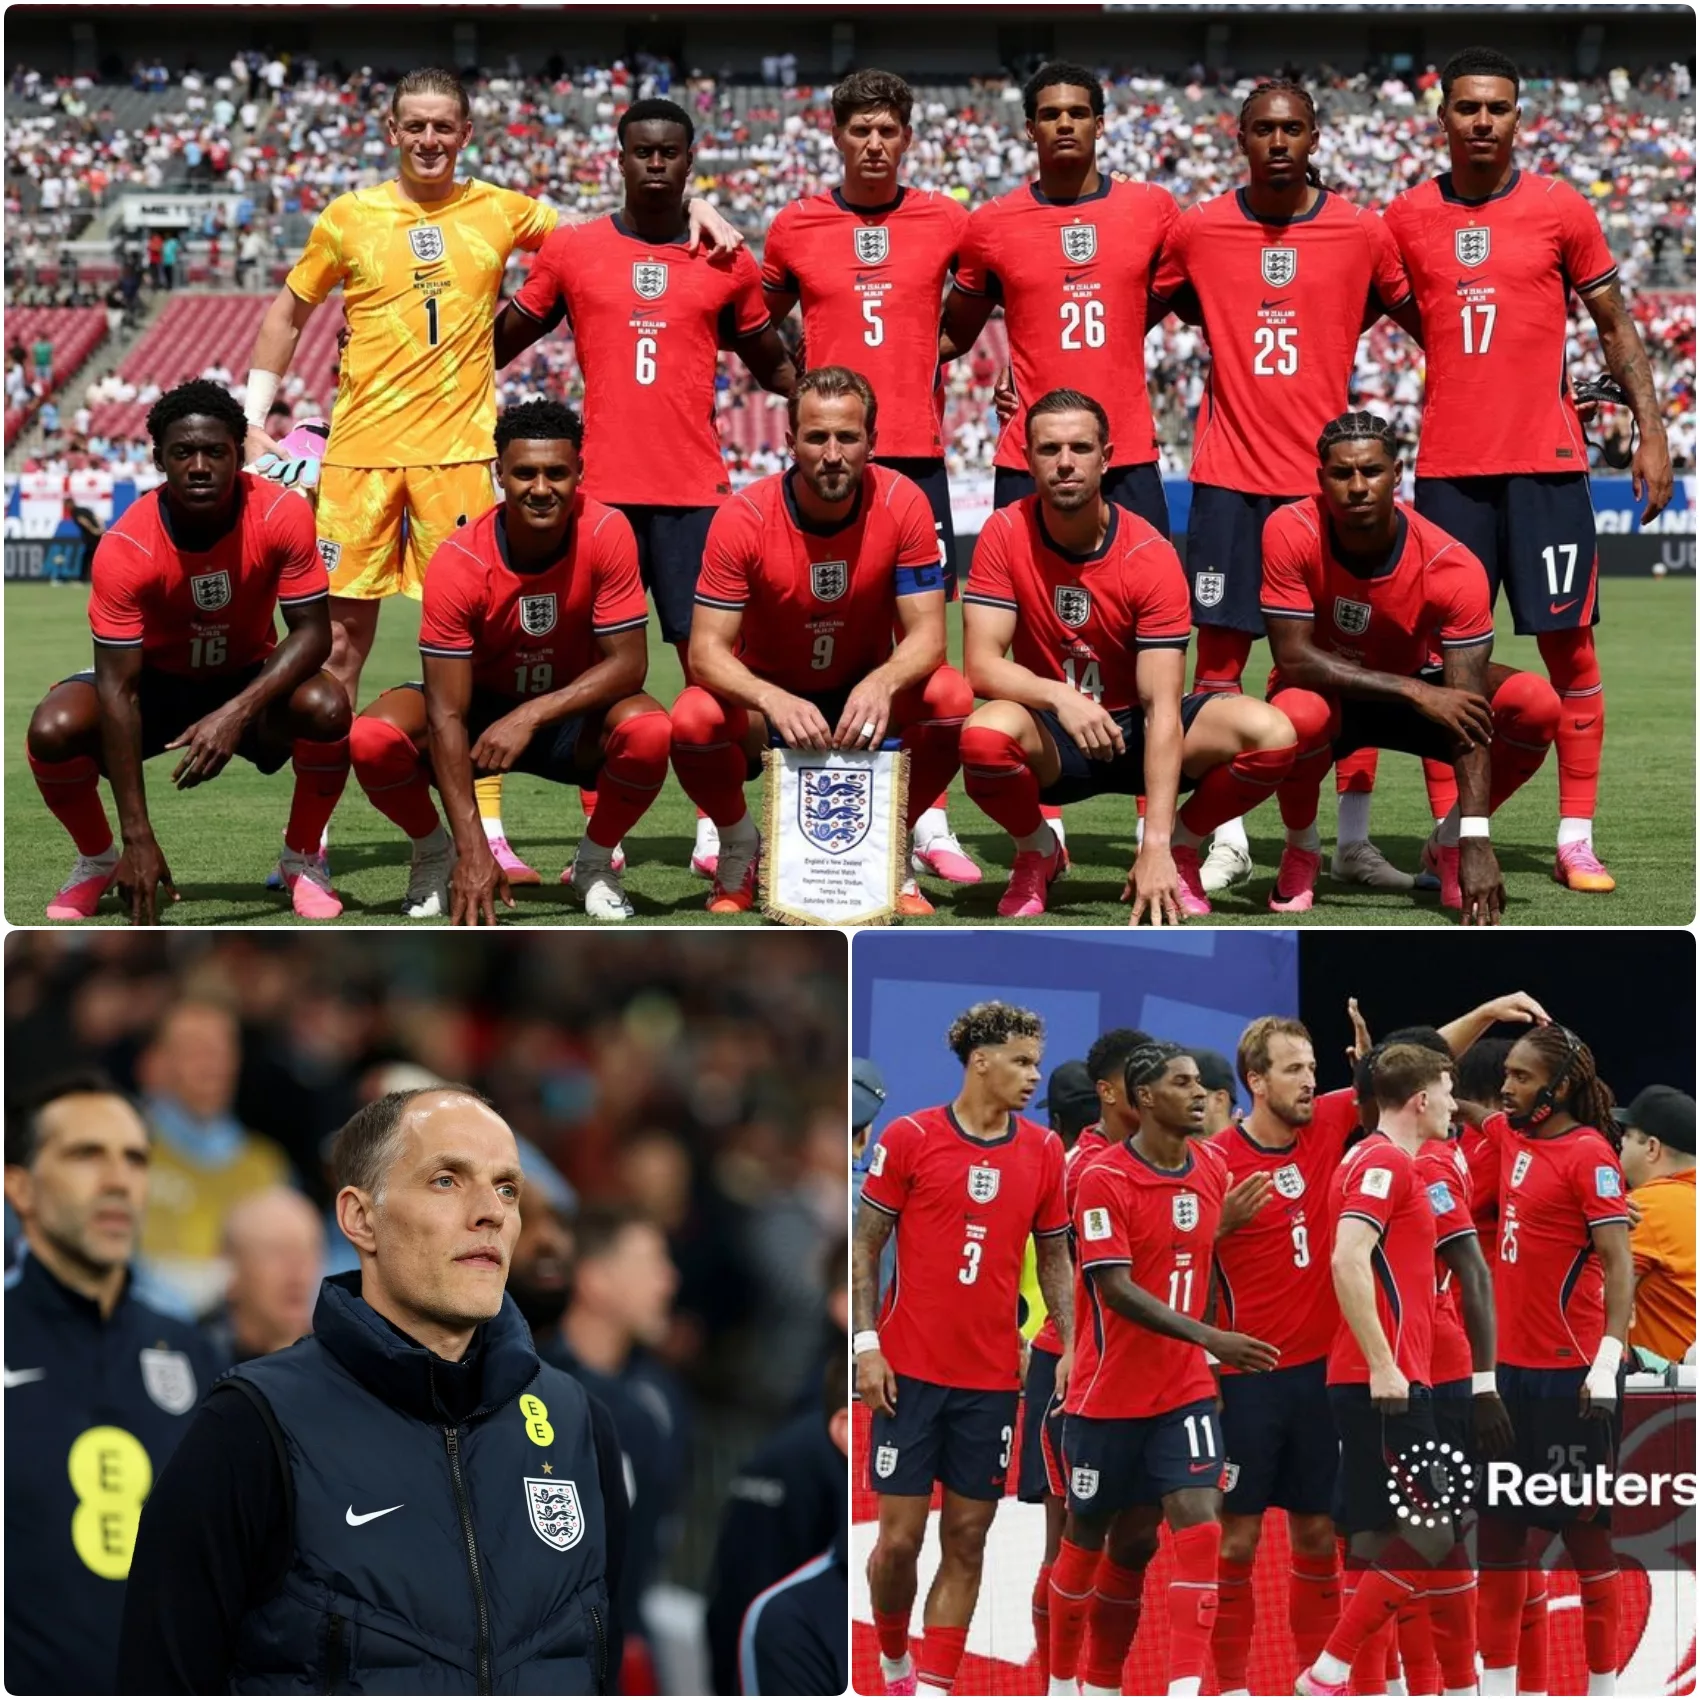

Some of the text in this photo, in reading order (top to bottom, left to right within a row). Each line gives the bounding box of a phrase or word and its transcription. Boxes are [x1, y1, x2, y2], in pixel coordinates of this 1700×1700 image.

[425, 298, 438, 345] 1
[863, 300, 883, 346] 5
[1060, 300, 1105, 349] 26
[1460, 304, 1496, 353] 17
[636, 337, 656, 385] 6
[1254, 327, 1298, 375] 25
[1542, 543, 1578, 595] 17
[189, 636, 227, 668] 16
[811, 635, 834, 670] 9
[514, 662, 553, 693] 19
[1062, 658, 1105, 704] 14
[958, 1241, 982, 1285] 3
[1292, 1225, 1310, 1268] 9
[1169, 1269, 1193, 1312] 11
[1000, 1424, 1012, 1469] 3
[1183, 1415, 1216, 1458] 11
